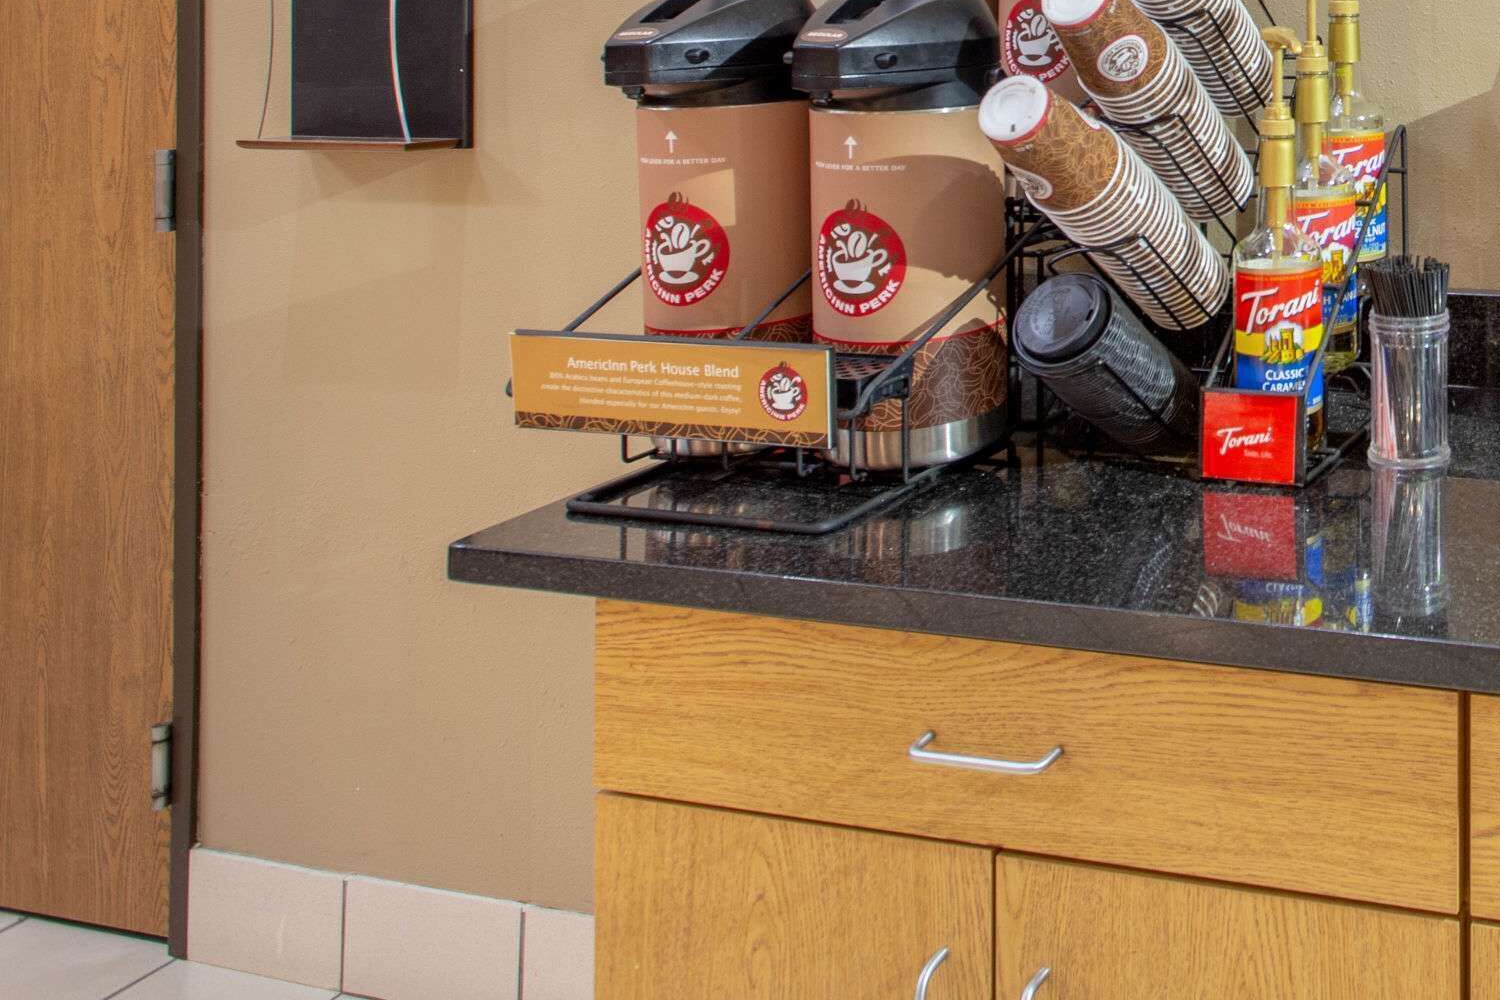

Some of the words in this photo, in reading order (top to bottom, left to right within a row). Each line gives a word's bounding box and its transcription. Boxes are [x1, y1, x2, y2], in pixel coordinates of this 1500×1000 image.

[684, 267, 724, 304] PERK
[859, 278, 901, 314] PERK
[1241, 279, 1320, 335] Torani
[630, 360, 657, 374] Perk
[660, 362, 700, 376] House
[703, 363, 740, 378] Blend
[1265, 367, 1304, 381] CLASSIC
[1216, 426, 1272, 456] Torani
